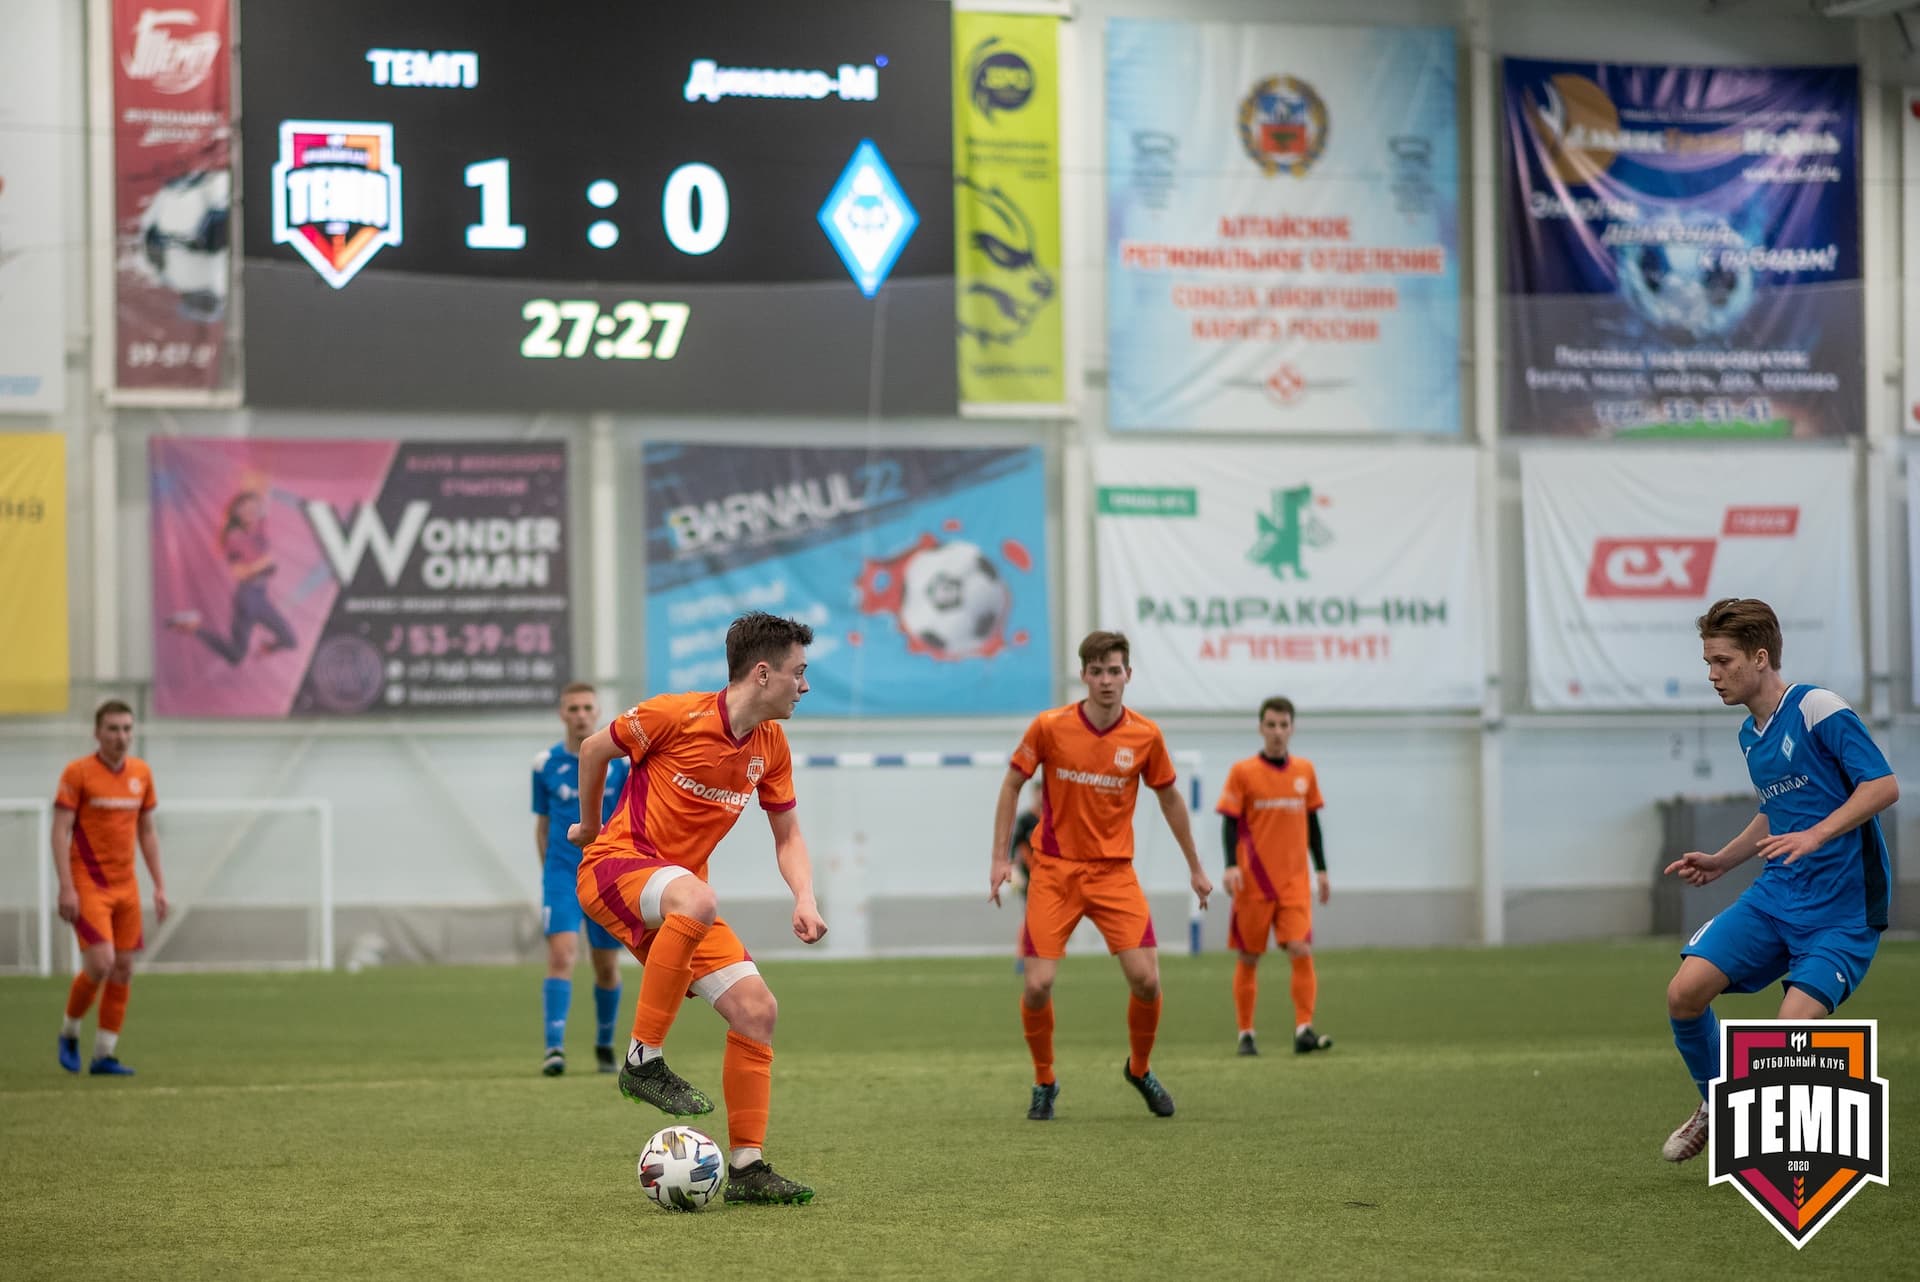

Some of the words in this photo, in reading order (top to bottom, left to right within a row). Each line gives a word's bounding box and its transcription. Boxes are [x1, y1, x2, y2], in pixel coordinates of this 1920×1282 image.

[366, 48, 479, 88] ТЕМП
[464, 159, 527, 249] 1
[662, 162, 730, 256] 0
[1217, 214, 1353, 242] АЛТАЙСКОЕ
[1121, 243, 1304, 272] РЕГИОНАЛЬНОЕ
[1310, 246, 1444, 274] ОТДЕЛЕНИЕ
[520, 299, 691, 360] 27:27
[667, 472, 868, 550] BARNAUL
[1199, 634, 1391, 663] АППЕТИТ!
